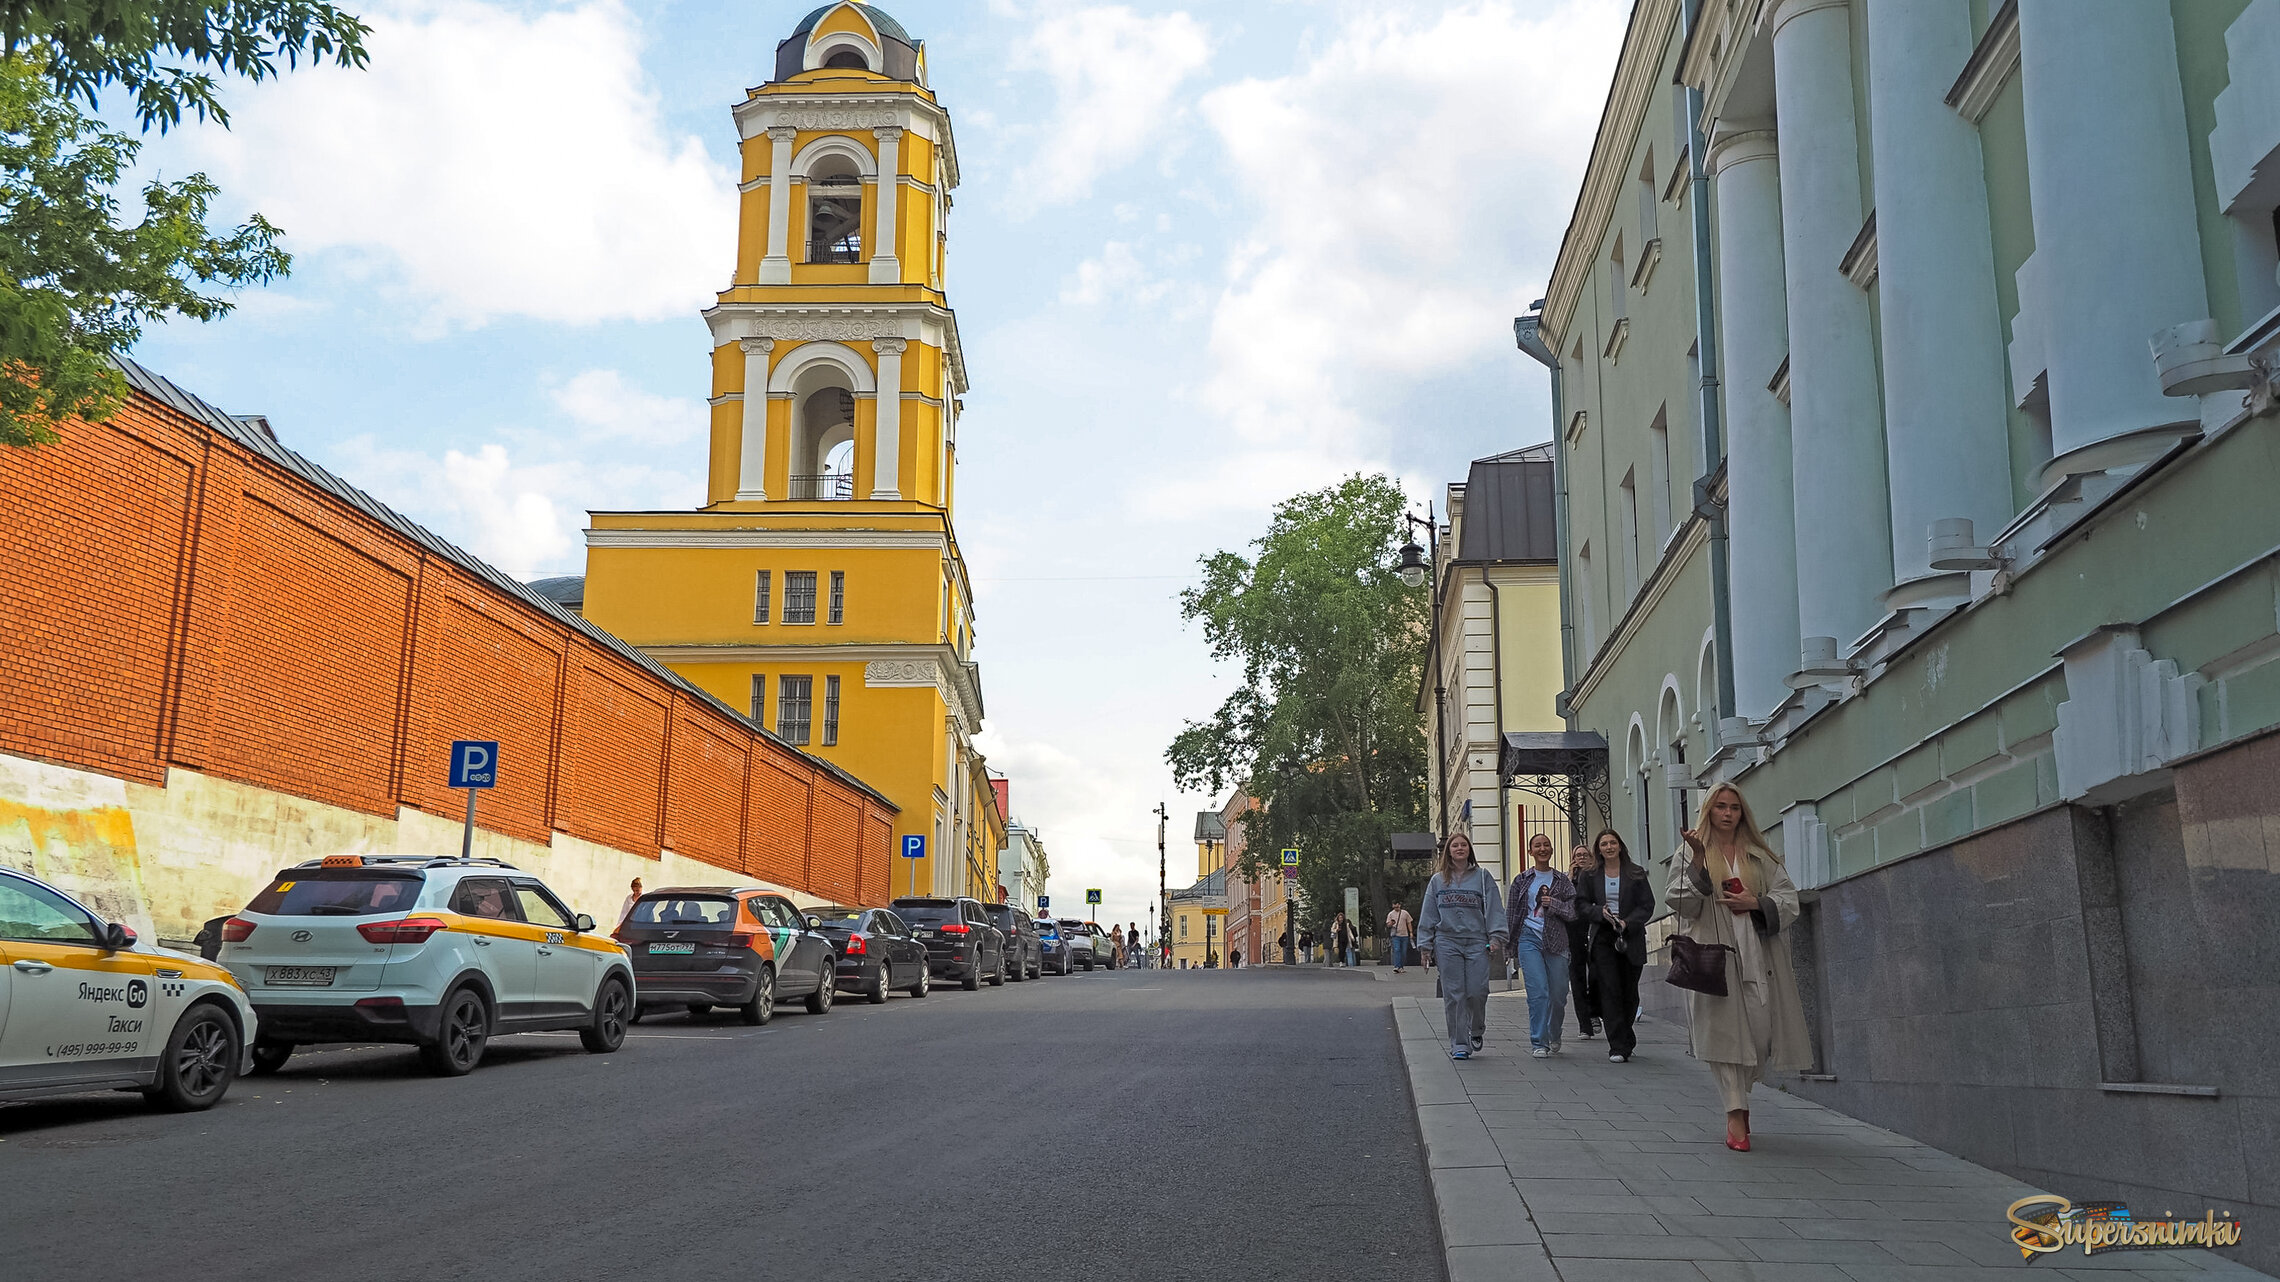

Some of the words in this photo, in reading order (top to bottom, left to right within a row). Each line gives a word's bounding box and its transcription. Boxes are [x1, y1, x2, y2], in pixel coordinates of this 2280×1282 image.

[462, 746, 489, 782] P
[908, 837, 921, 856] P
[78, 982, 124, 1003] Яндекс
[129, 984, 146, 1003] Go
[107, 1015, 143, 1033] Такси
[56, 1044, 84, 1058] (495)
[85, 1041, 138, 1055] 999-99-99
